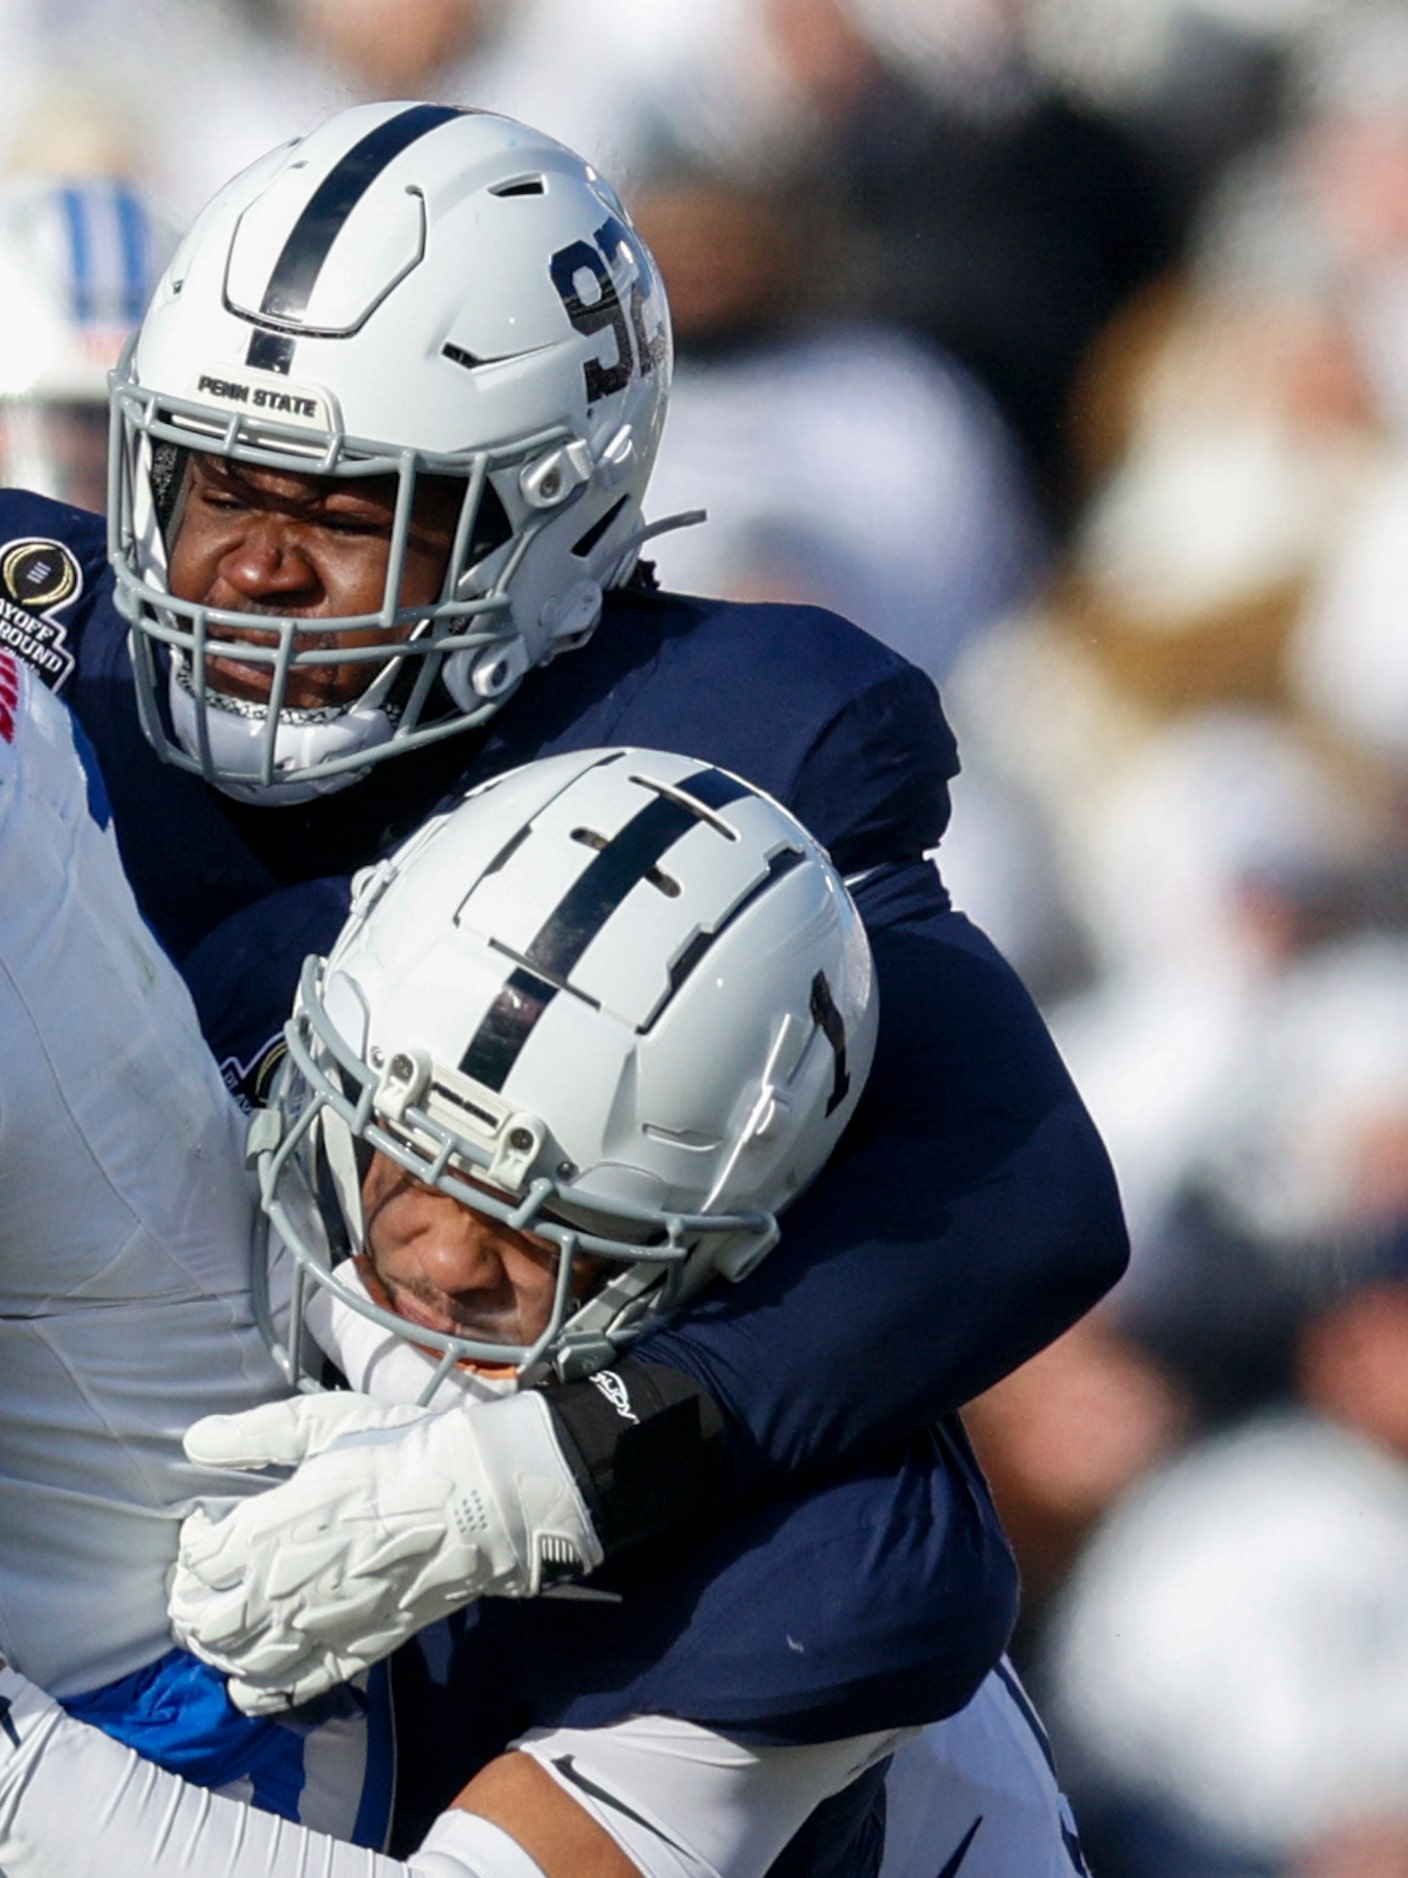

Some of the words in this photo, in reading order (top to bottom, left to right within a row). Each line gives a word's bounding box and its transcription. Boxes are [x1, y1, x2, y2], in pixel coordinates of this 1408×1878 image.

[549, 216, 667, 404] 92
[197, 375, 249, 404] PENN
[252, 388, 318, 418] STATE
